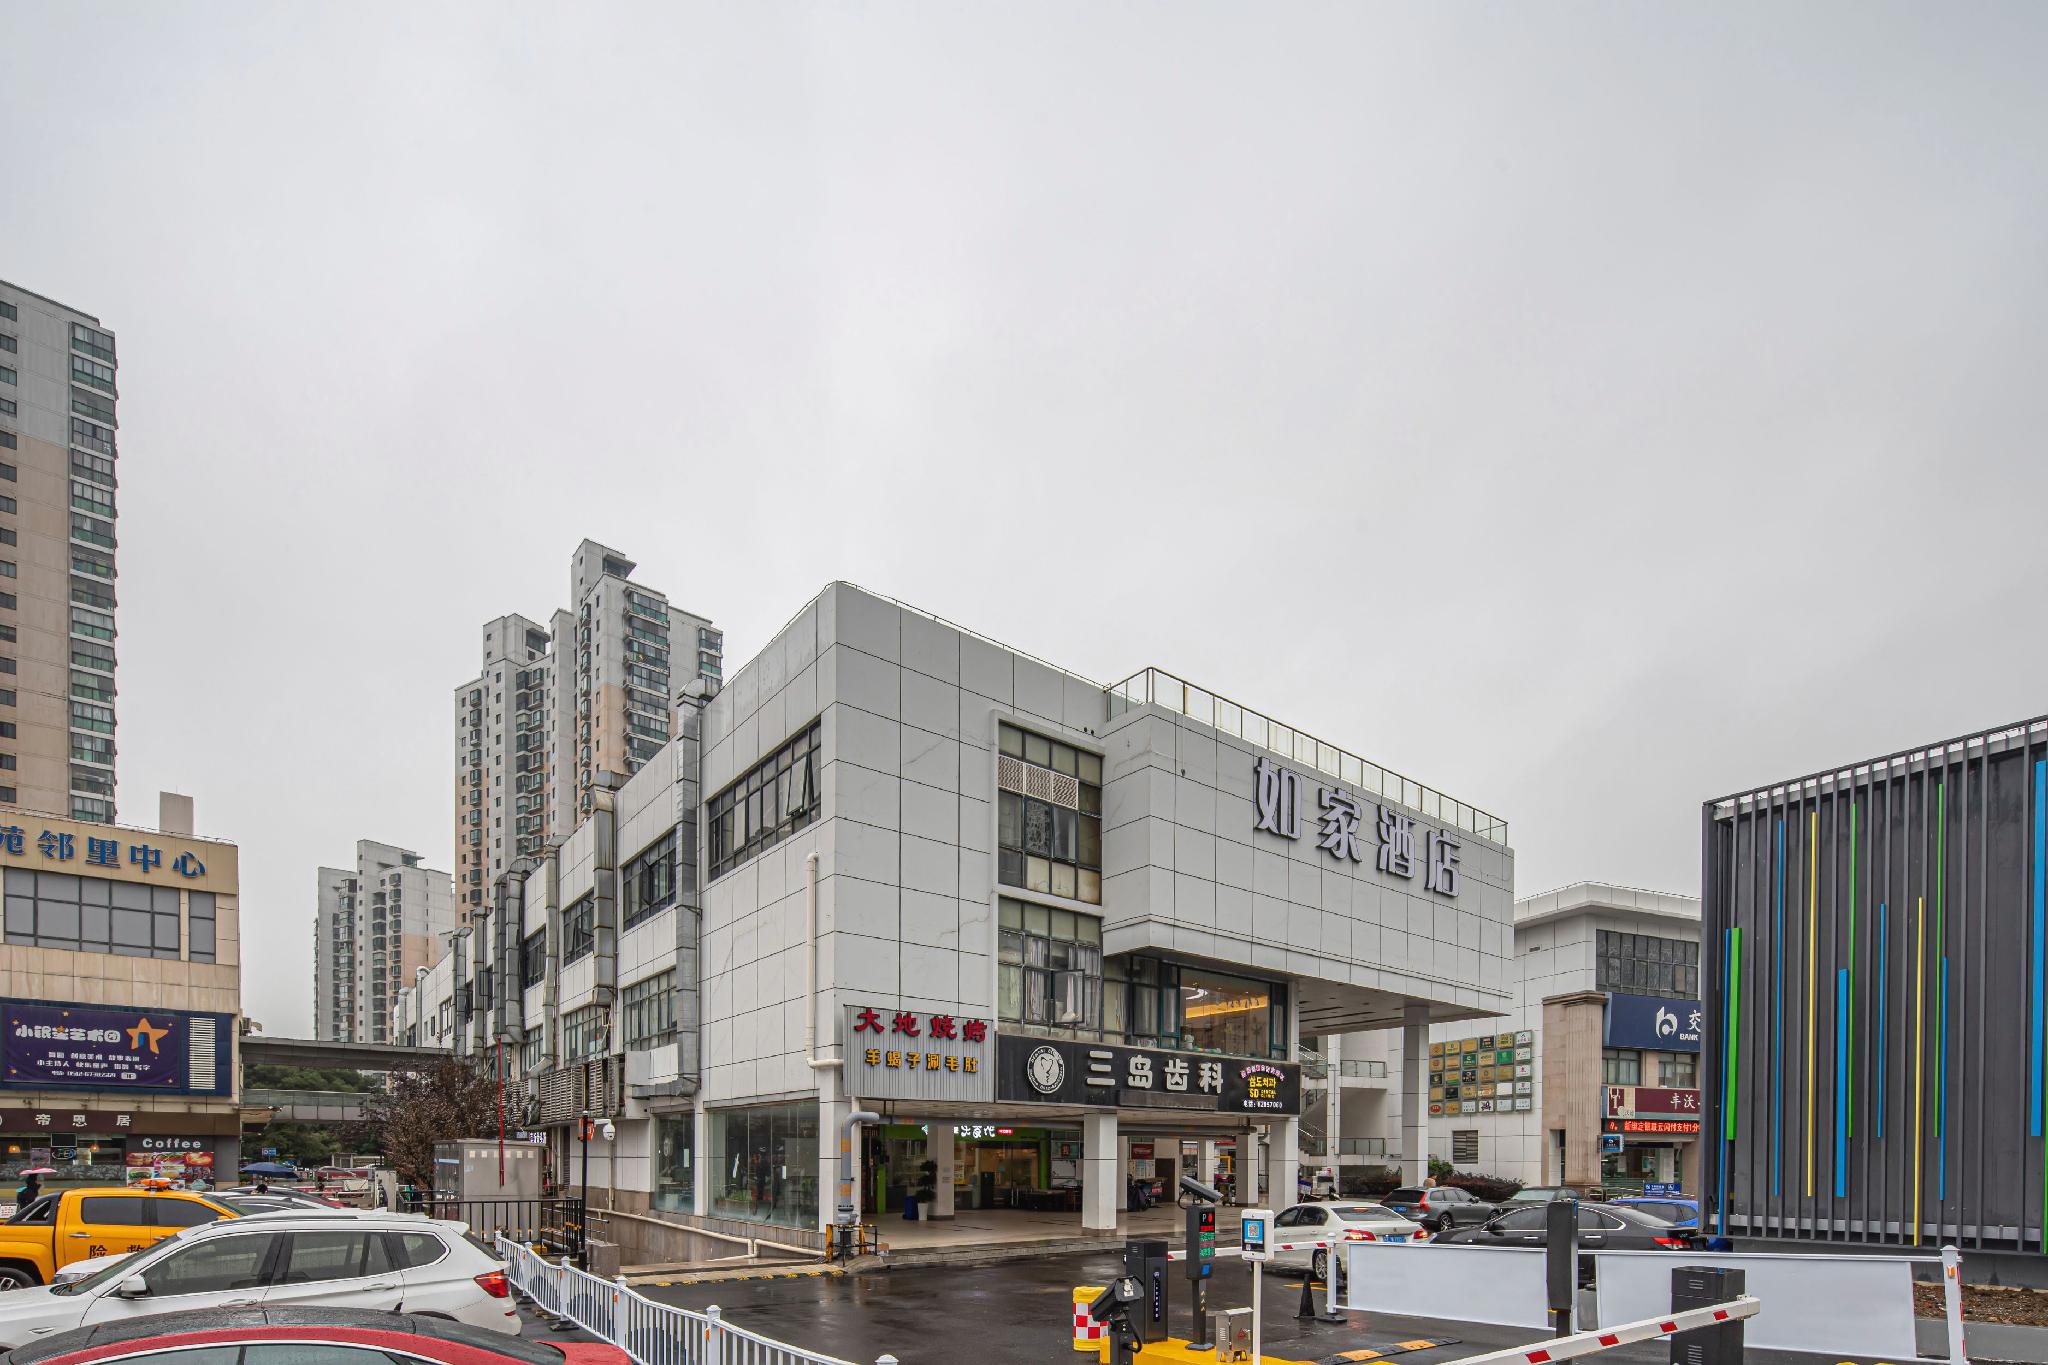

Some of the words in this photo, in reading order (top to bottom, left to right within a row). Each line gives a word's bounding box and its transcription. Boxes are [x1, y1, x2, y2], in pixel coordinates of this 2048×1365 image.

[1253, 757, 1460, 896] 如家酒店
[854, 1007, 987, 1042] 大地烧烤
[1679, 1033, 1699, 1041] BANK
[865, 1048, 978, 1073] 羊蝎子涮毛肚
[1086, 1050, 1223, 1094] 三岛齿科
[1249, 1088, 1259, 1098] SD
[35, 1114, 131, 1127] 帝恩居
[142, 1138, 201, 1149] Coffee
